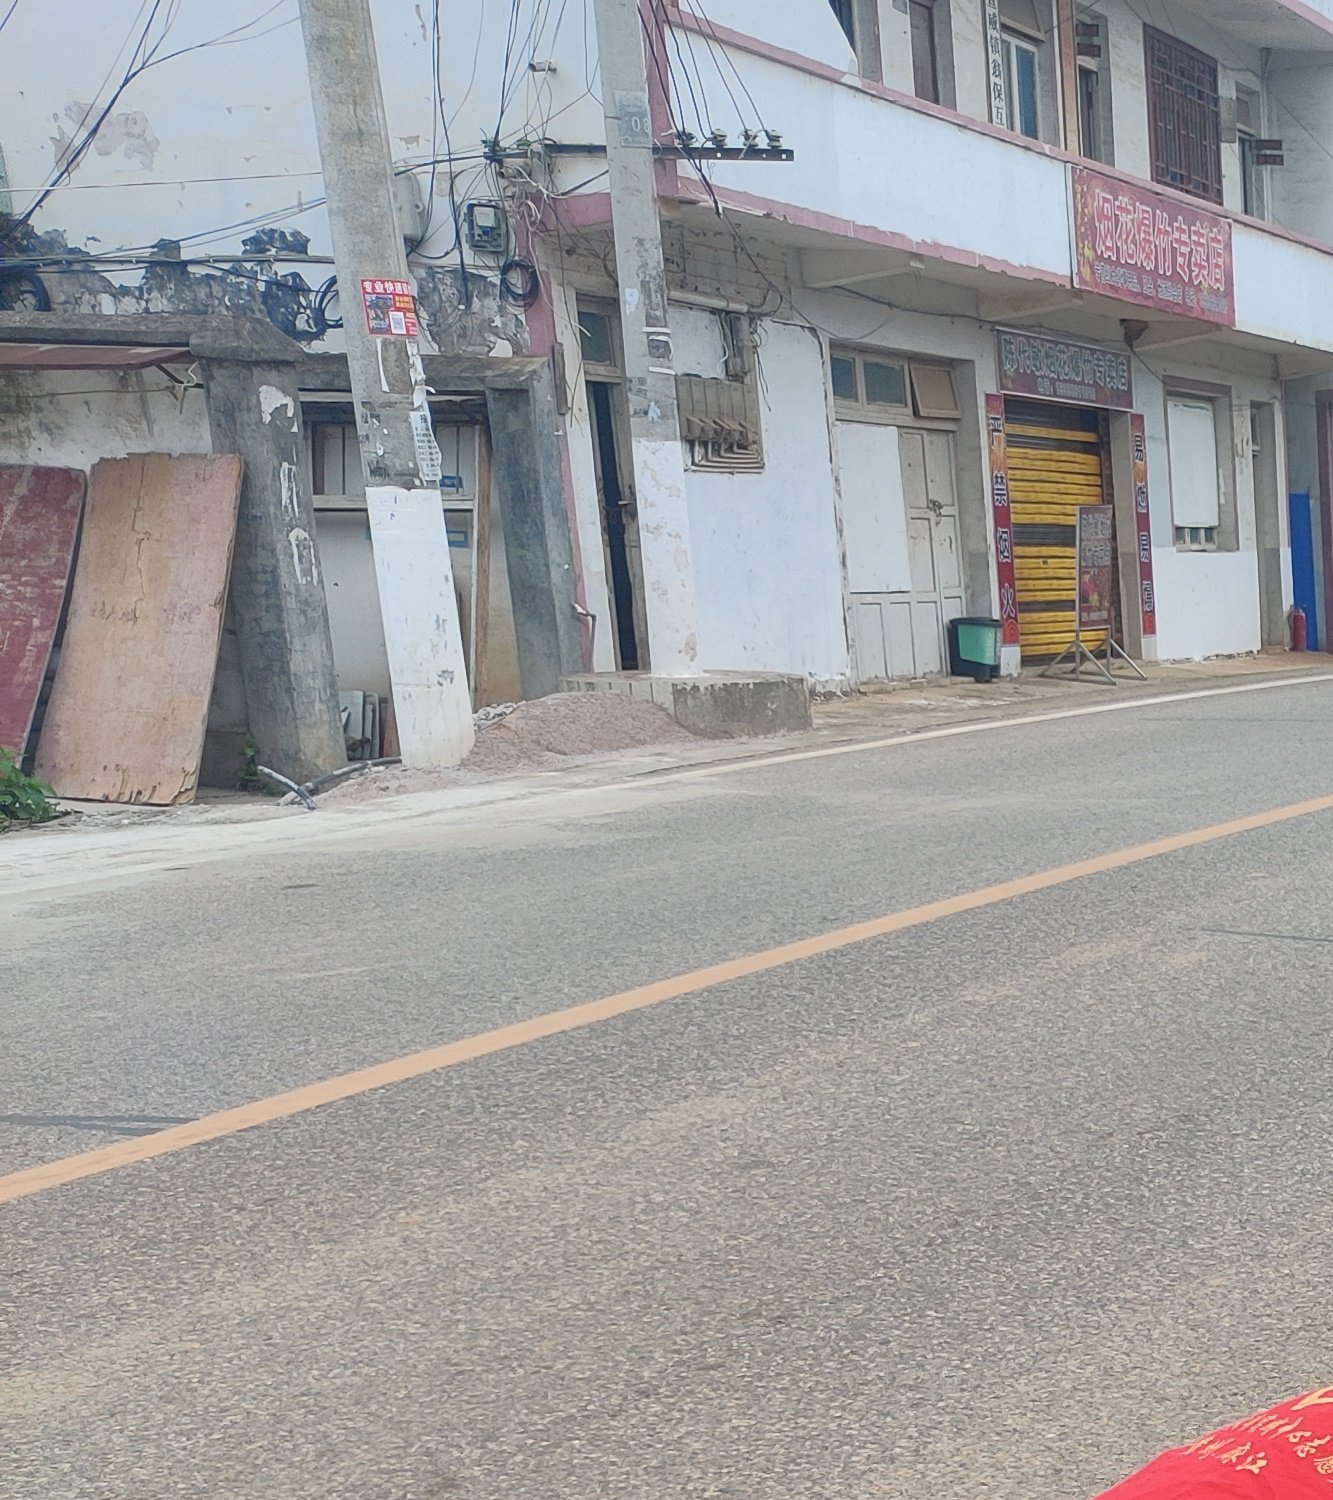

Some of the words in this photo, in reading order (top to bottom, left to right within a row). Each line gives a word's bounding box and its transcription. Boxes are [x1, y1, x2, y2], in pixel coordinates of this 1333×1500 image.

[1093, 189, 1226, 292] 烟花爆竹专卖店
[988, 414, 1016, 619] 严禁烟火
